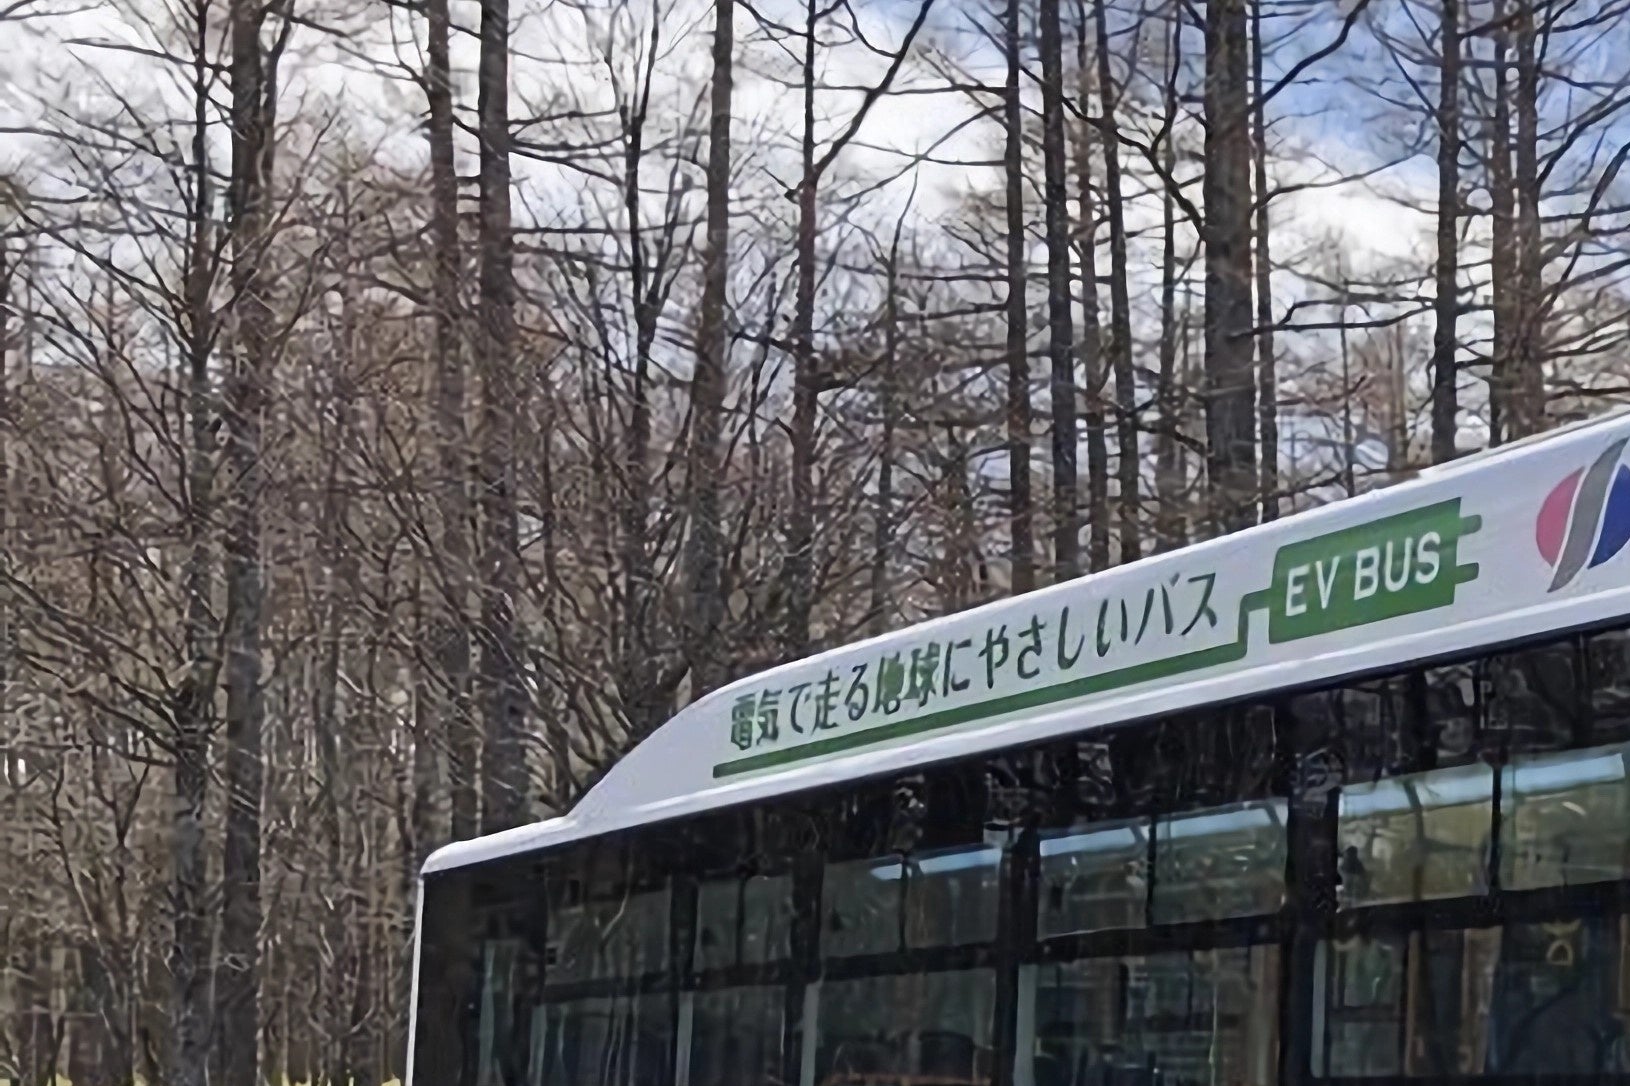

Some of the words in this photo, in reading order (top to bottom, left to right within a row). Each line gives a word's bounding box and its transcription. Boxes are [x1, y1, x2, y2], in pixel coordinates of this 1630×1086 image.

[1284, 562, 1339, 616] EV
[1353, 530, 1443, 593] BUS
[730, 572, 1219, 751] 電気で走る地球にやさしいバス
